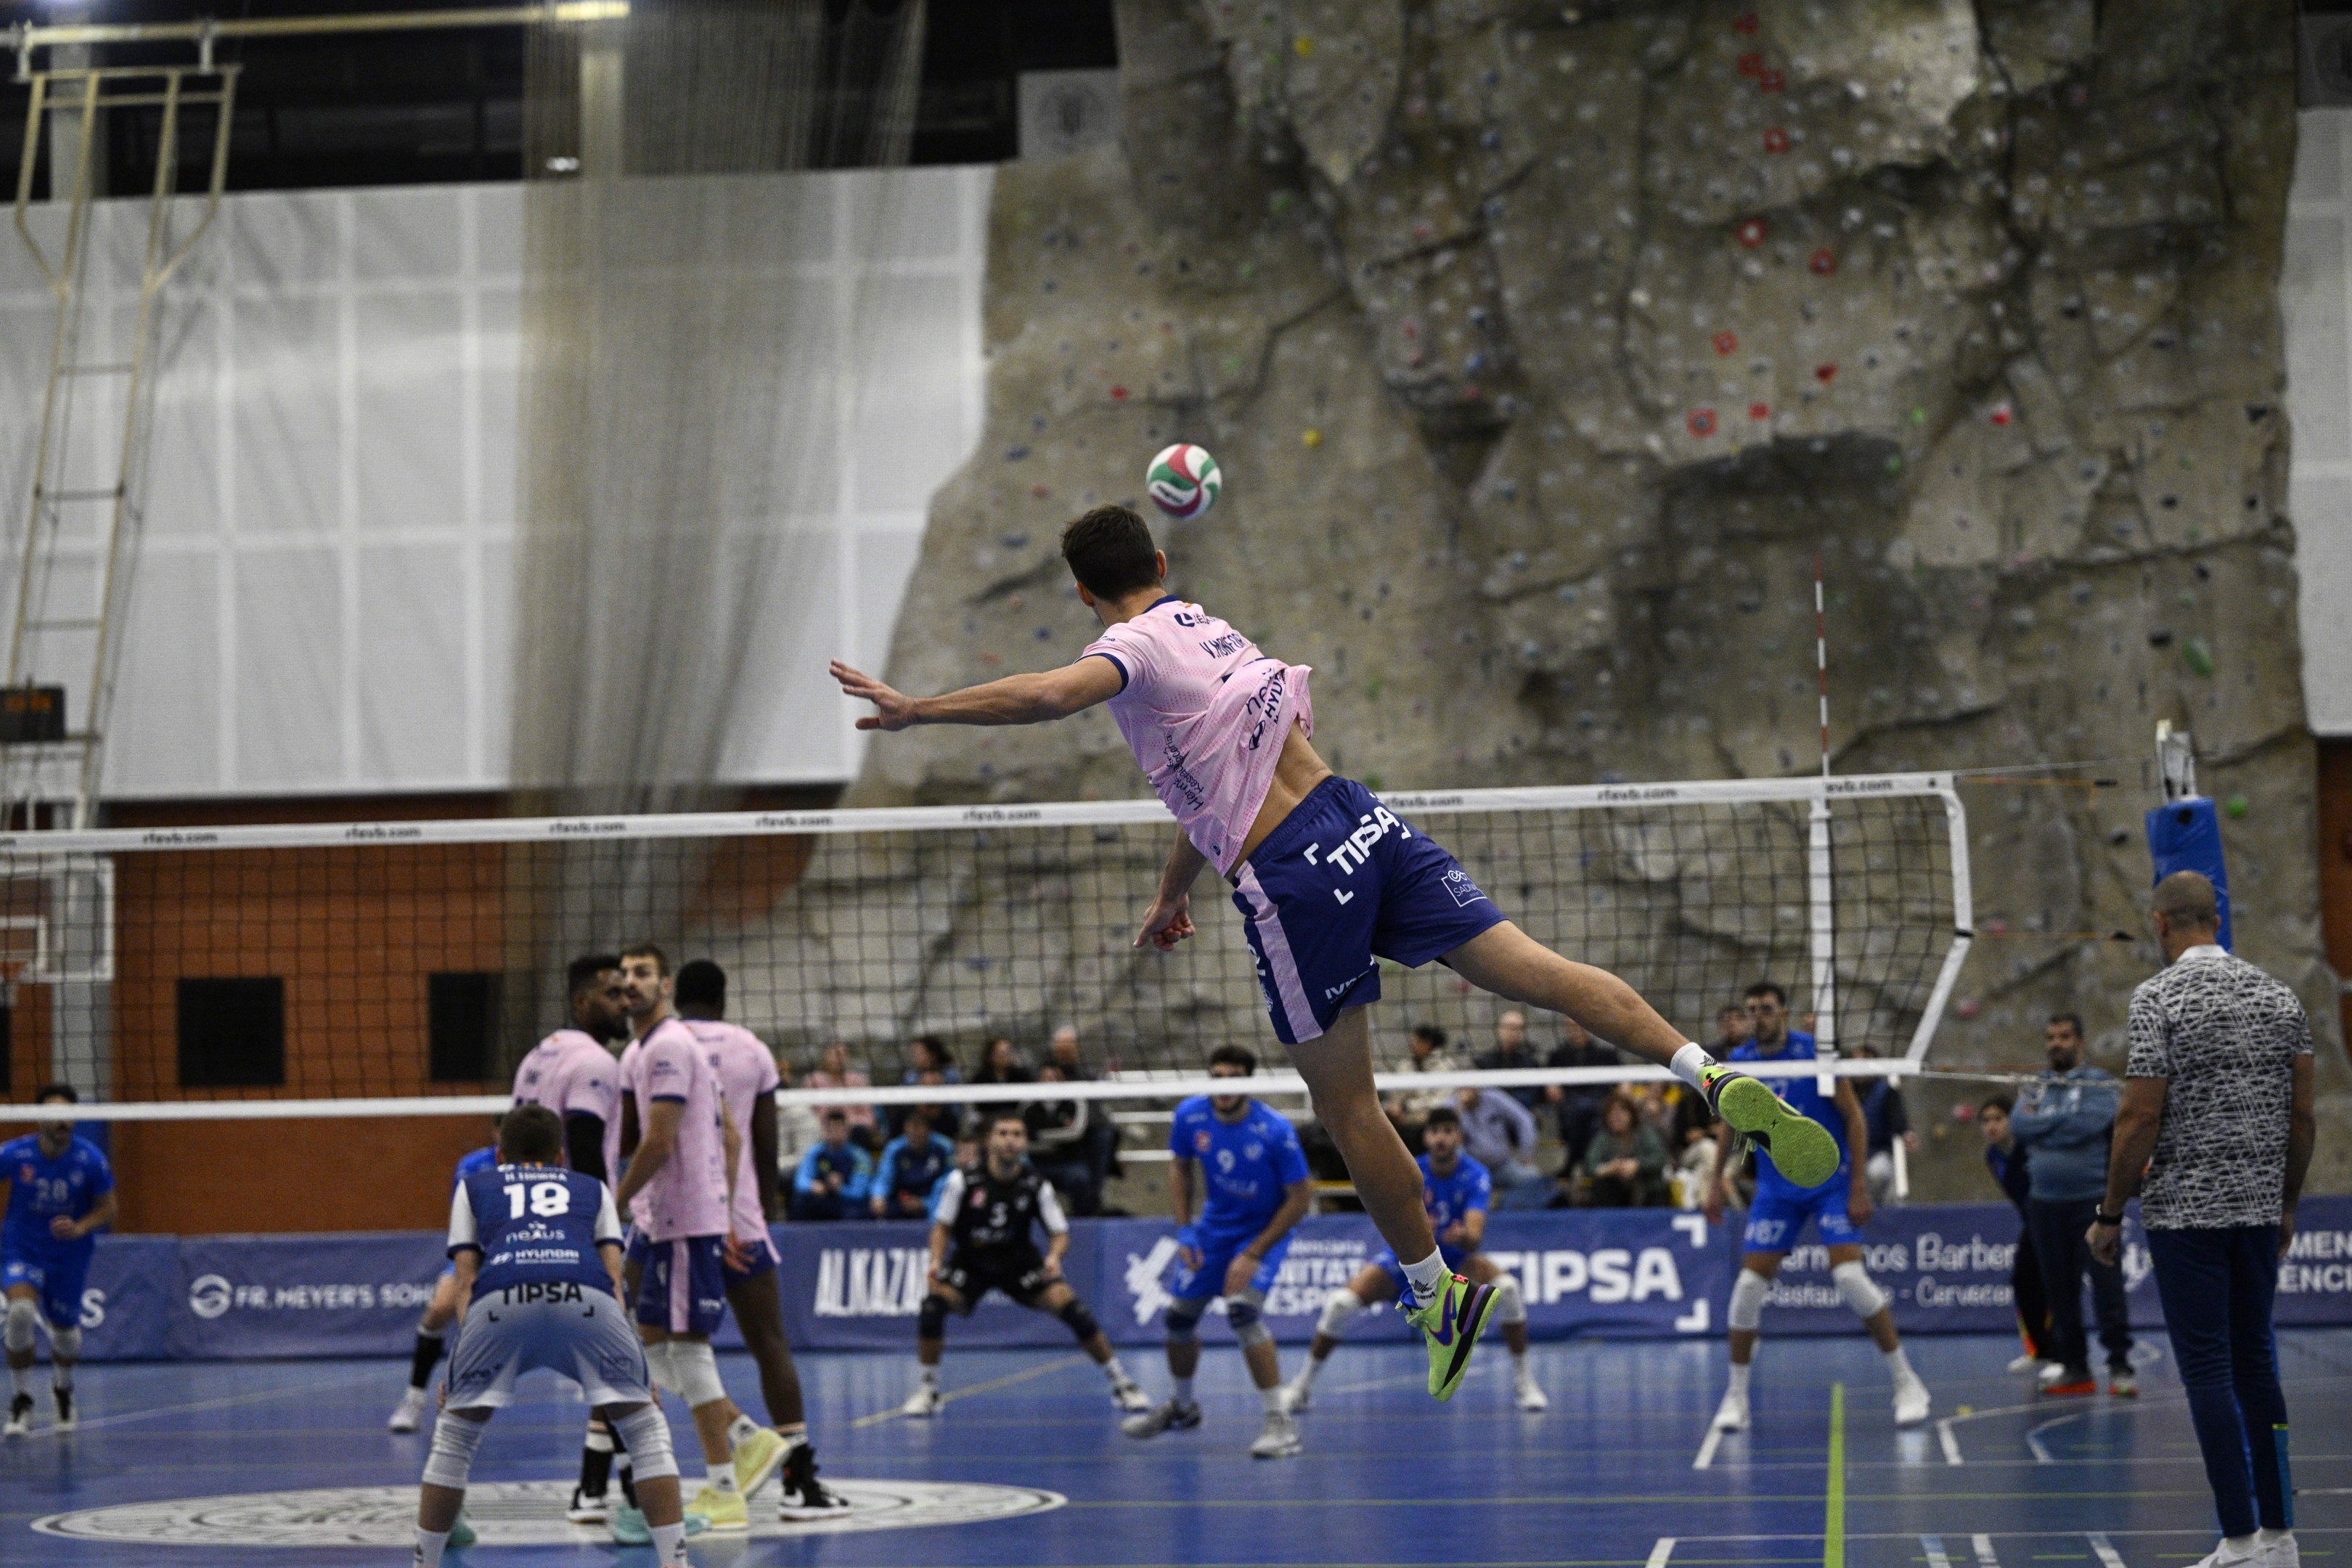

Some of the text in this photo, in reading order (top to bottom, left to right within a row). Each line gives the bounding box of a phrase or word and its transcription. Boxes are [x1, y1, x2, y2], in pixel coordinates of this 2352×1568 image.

[1217, 1148, 1235, 1173] 9
[503, 1181, 571, 1220] 18
[502, 1283, 583, 1305] TIPSA
